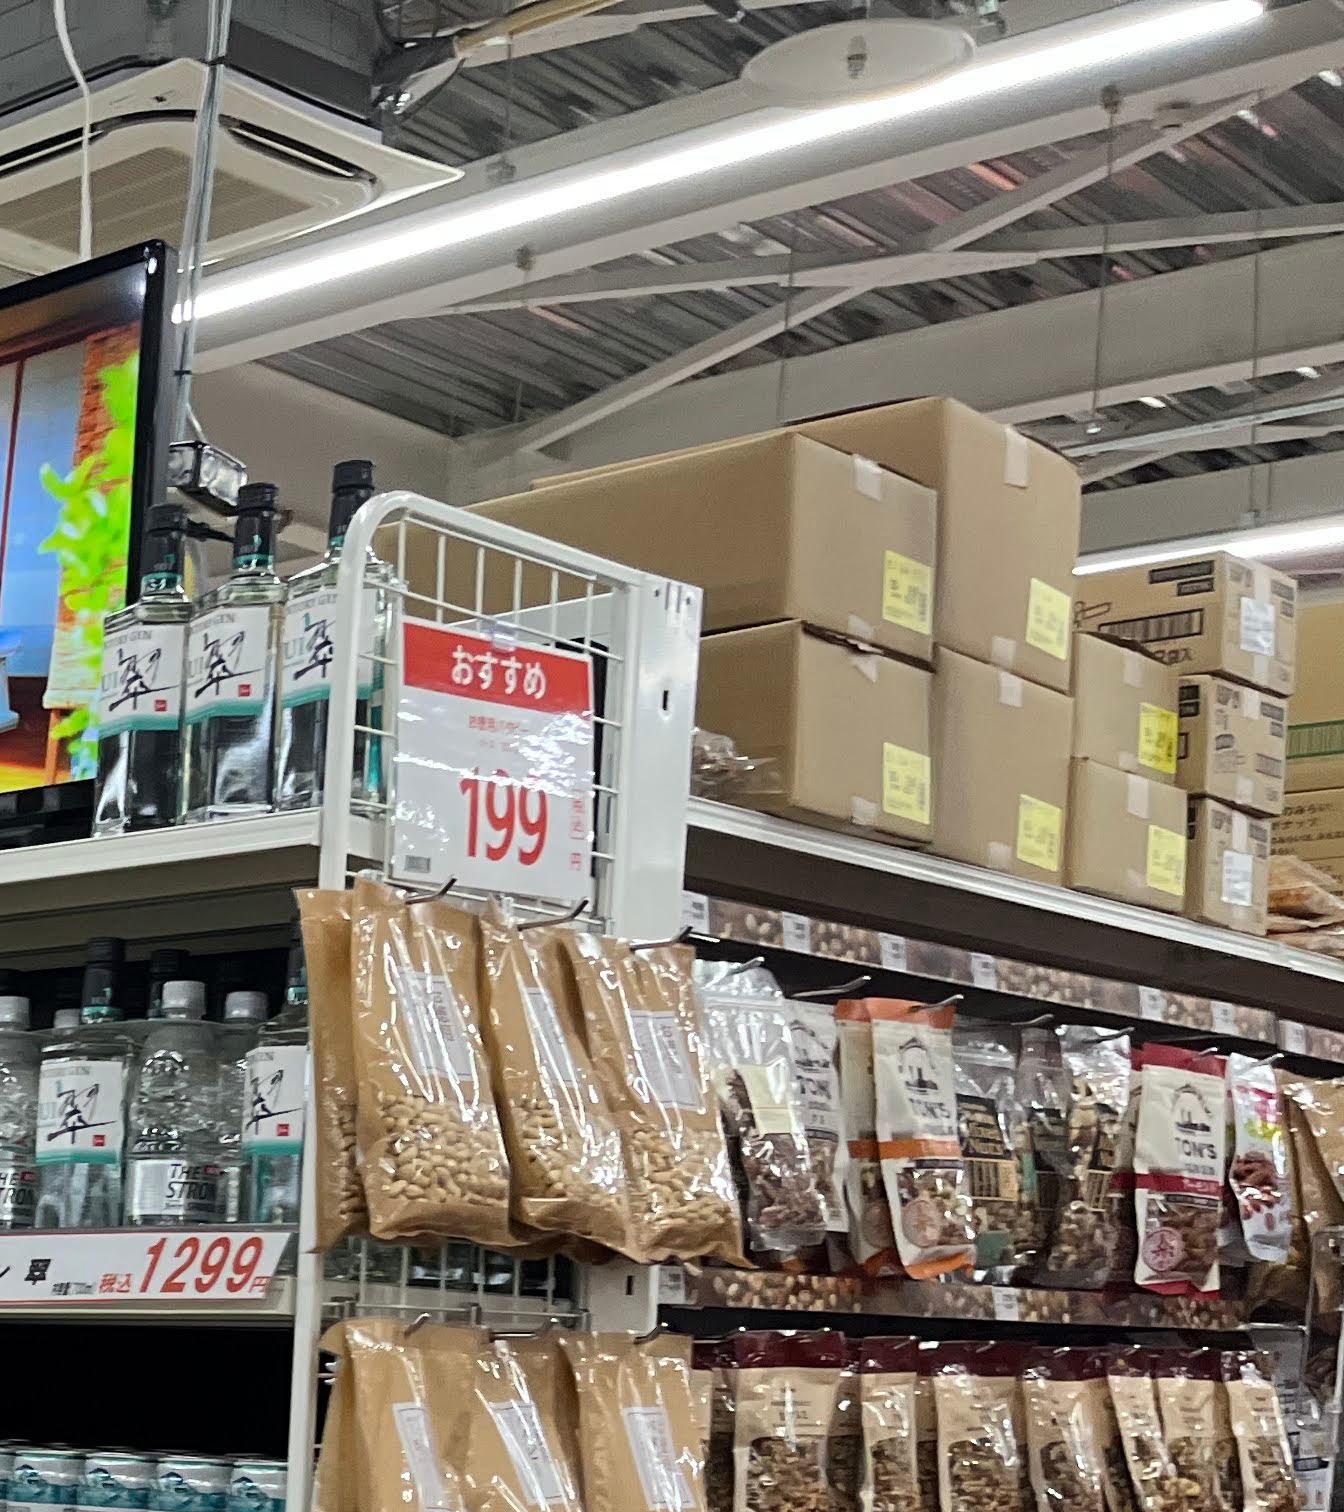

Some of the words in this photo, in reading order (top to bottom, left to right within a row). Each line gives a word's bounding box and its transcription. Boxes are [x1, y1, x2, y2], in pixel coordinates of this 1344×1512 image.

[451, 644, 547, 700] おすすめ
[458, 766, 548, 866] 199
[98, 1273, 133, 1294] 税込
[138, 1236, 265, 1294] 1299
